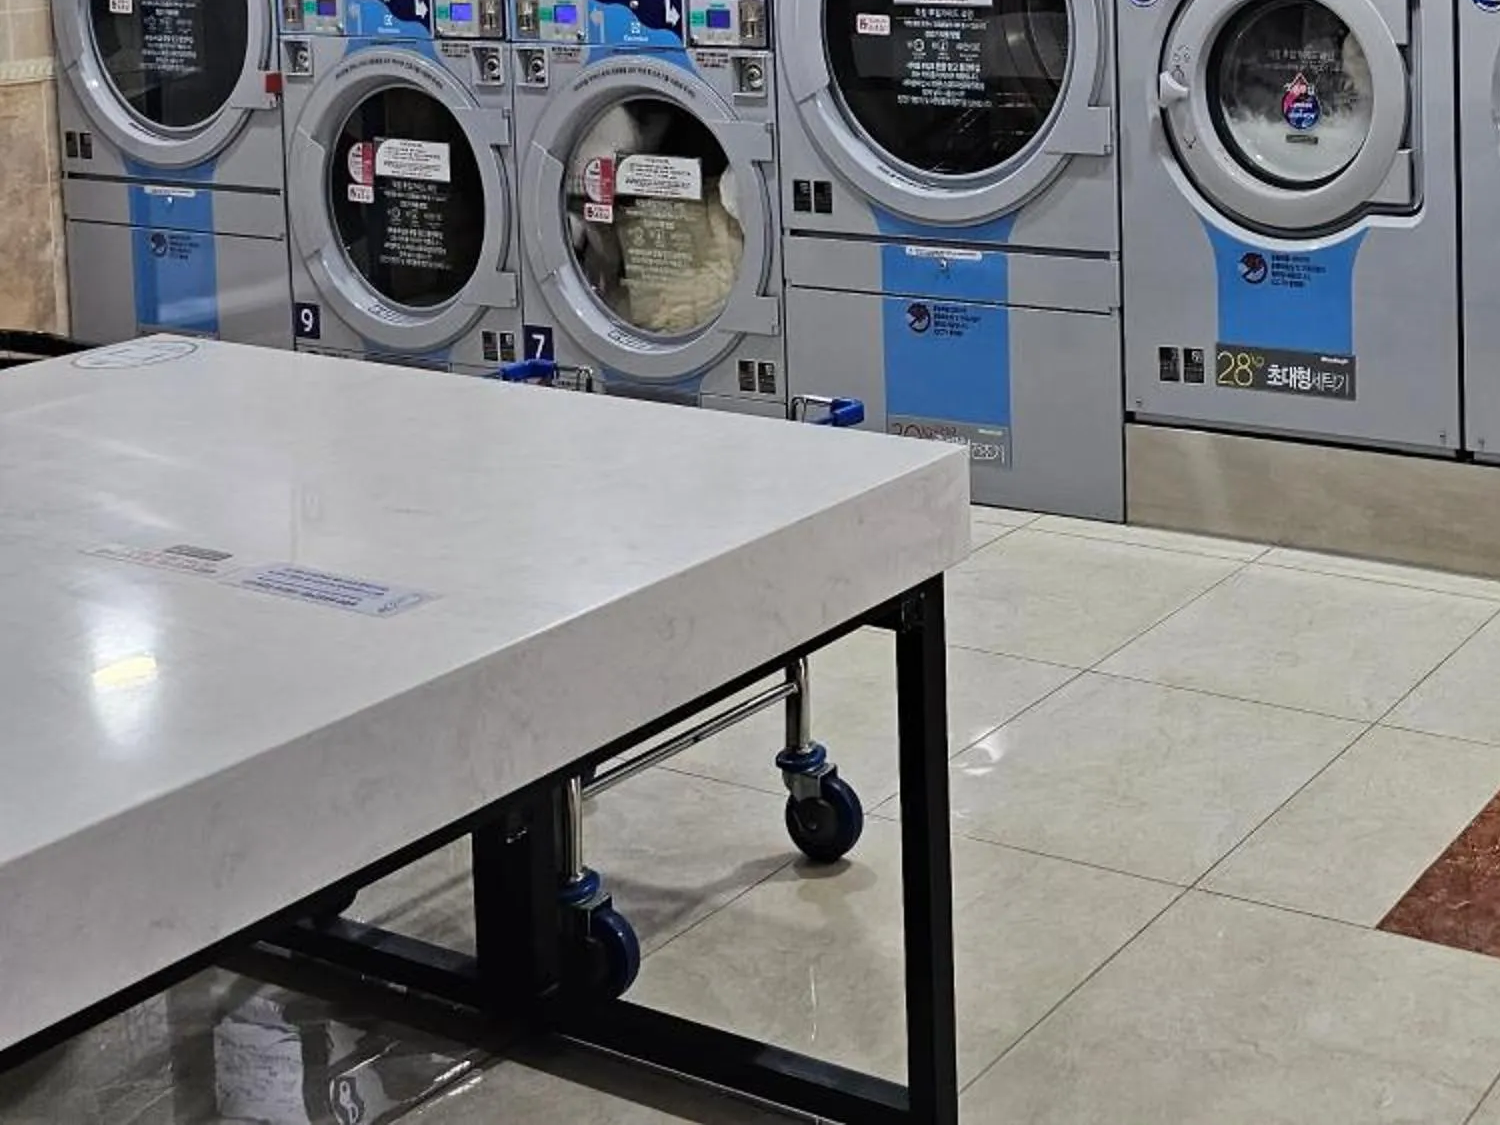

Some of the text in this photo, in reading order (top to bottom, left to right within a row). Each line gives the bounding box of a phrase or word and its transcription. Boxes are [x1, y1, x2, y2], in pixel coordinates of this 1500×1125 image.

[301, 308, 313, 332] 9
[532, 335, 546, 359] 7
[1266, 364, 1349, 395] 초대형세탁기
